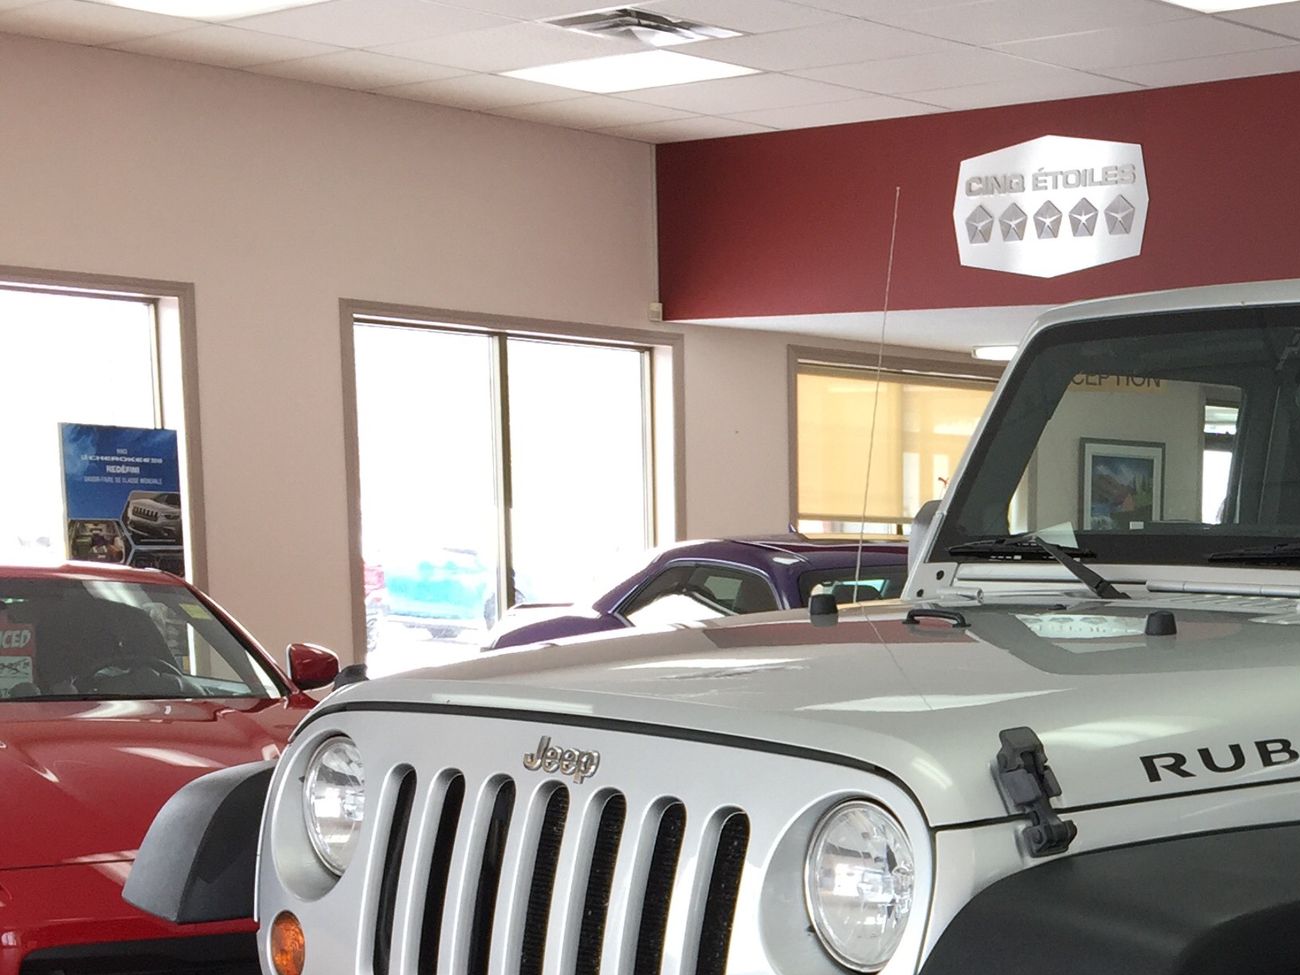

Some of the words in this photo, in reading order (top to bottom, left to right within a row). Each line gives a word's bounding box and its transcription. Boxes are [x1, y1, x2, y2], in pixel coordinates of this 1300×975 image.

[965, 173, 1026, 197] CINQ
[1032, 163, 1137, 192] ÉTOILES
[523, 735, 600, 784] Jeep
